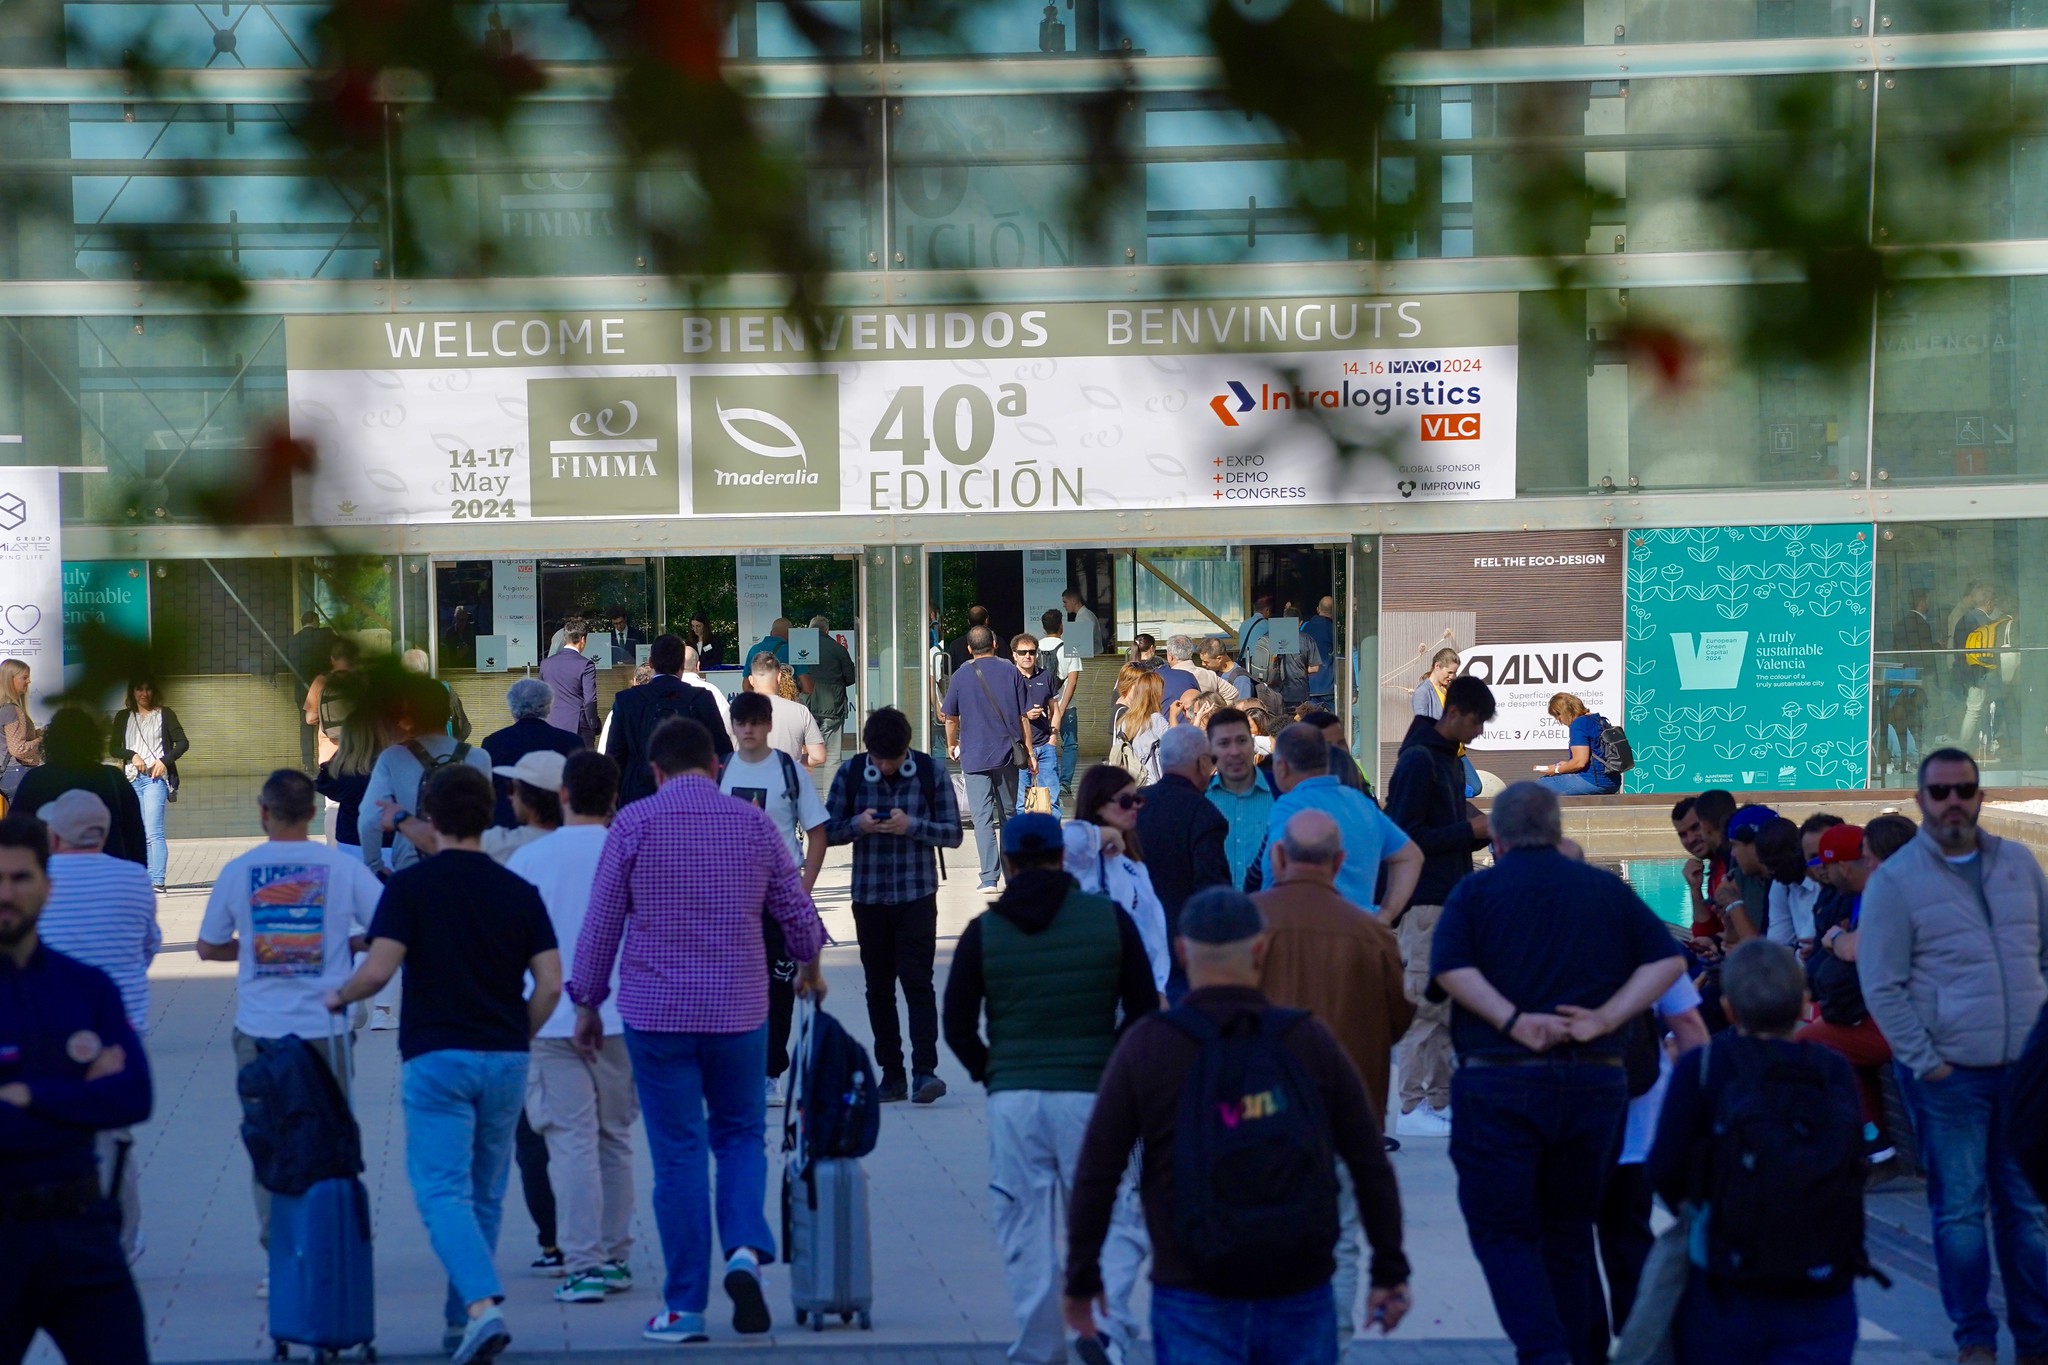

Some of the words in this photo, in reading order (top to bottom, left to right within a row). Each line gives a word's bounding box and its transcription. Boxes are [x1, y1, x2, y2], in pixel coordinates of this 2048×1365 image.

[502, 211, 615, 237] FIMMA
[682, 311, 1048, 353] BIENVENIDOS
[1106, 301, 1422, 345] BENVINGUTS
[384, 318, 625, 358] WELCOME
[1388, 359, 1441, 374] MAYO
[1443, 358, 1482, 374] 2024
[1262, 380, 1481, 415] Intralogistics
[1424, 416, 1478, 437] VLC
[449, 448, 514, 468] 14-17
[550, 454, 657, 479] FIMMA
[714, 469, 819, 486] maderalia
[1398, 465, 1434, 474] GLOBAL
[1436, 463, 1480, 473] SPONSOR
[451, 472, 510, 496] May
[869, 460, 1083, 511] EDICIÓN
[1421, 481, 1481, 491] IMPROVING
[451, 499, 516, 519] 2024
[1474, 558, 1502, 567] FEEL
[1503, 557, 1526, 566] THE
[1528, 554, 1606, 566] ECO-DESIGN
[1756, 632, 1765, 643] A
[1768, 631, 1796, 645] truly
[1756, 644, 1824, 657] sustainable
[1496, 652, 1604, 686] ALVIC
[1756, 658, 1806, 670] Valencia
[1507, 699, 1549, 709] despierta
[1539, 718, 1562, 727] STA
[1514, 731, 1521, 739] 3
[1532, 729, 1568, 739] PABEL
